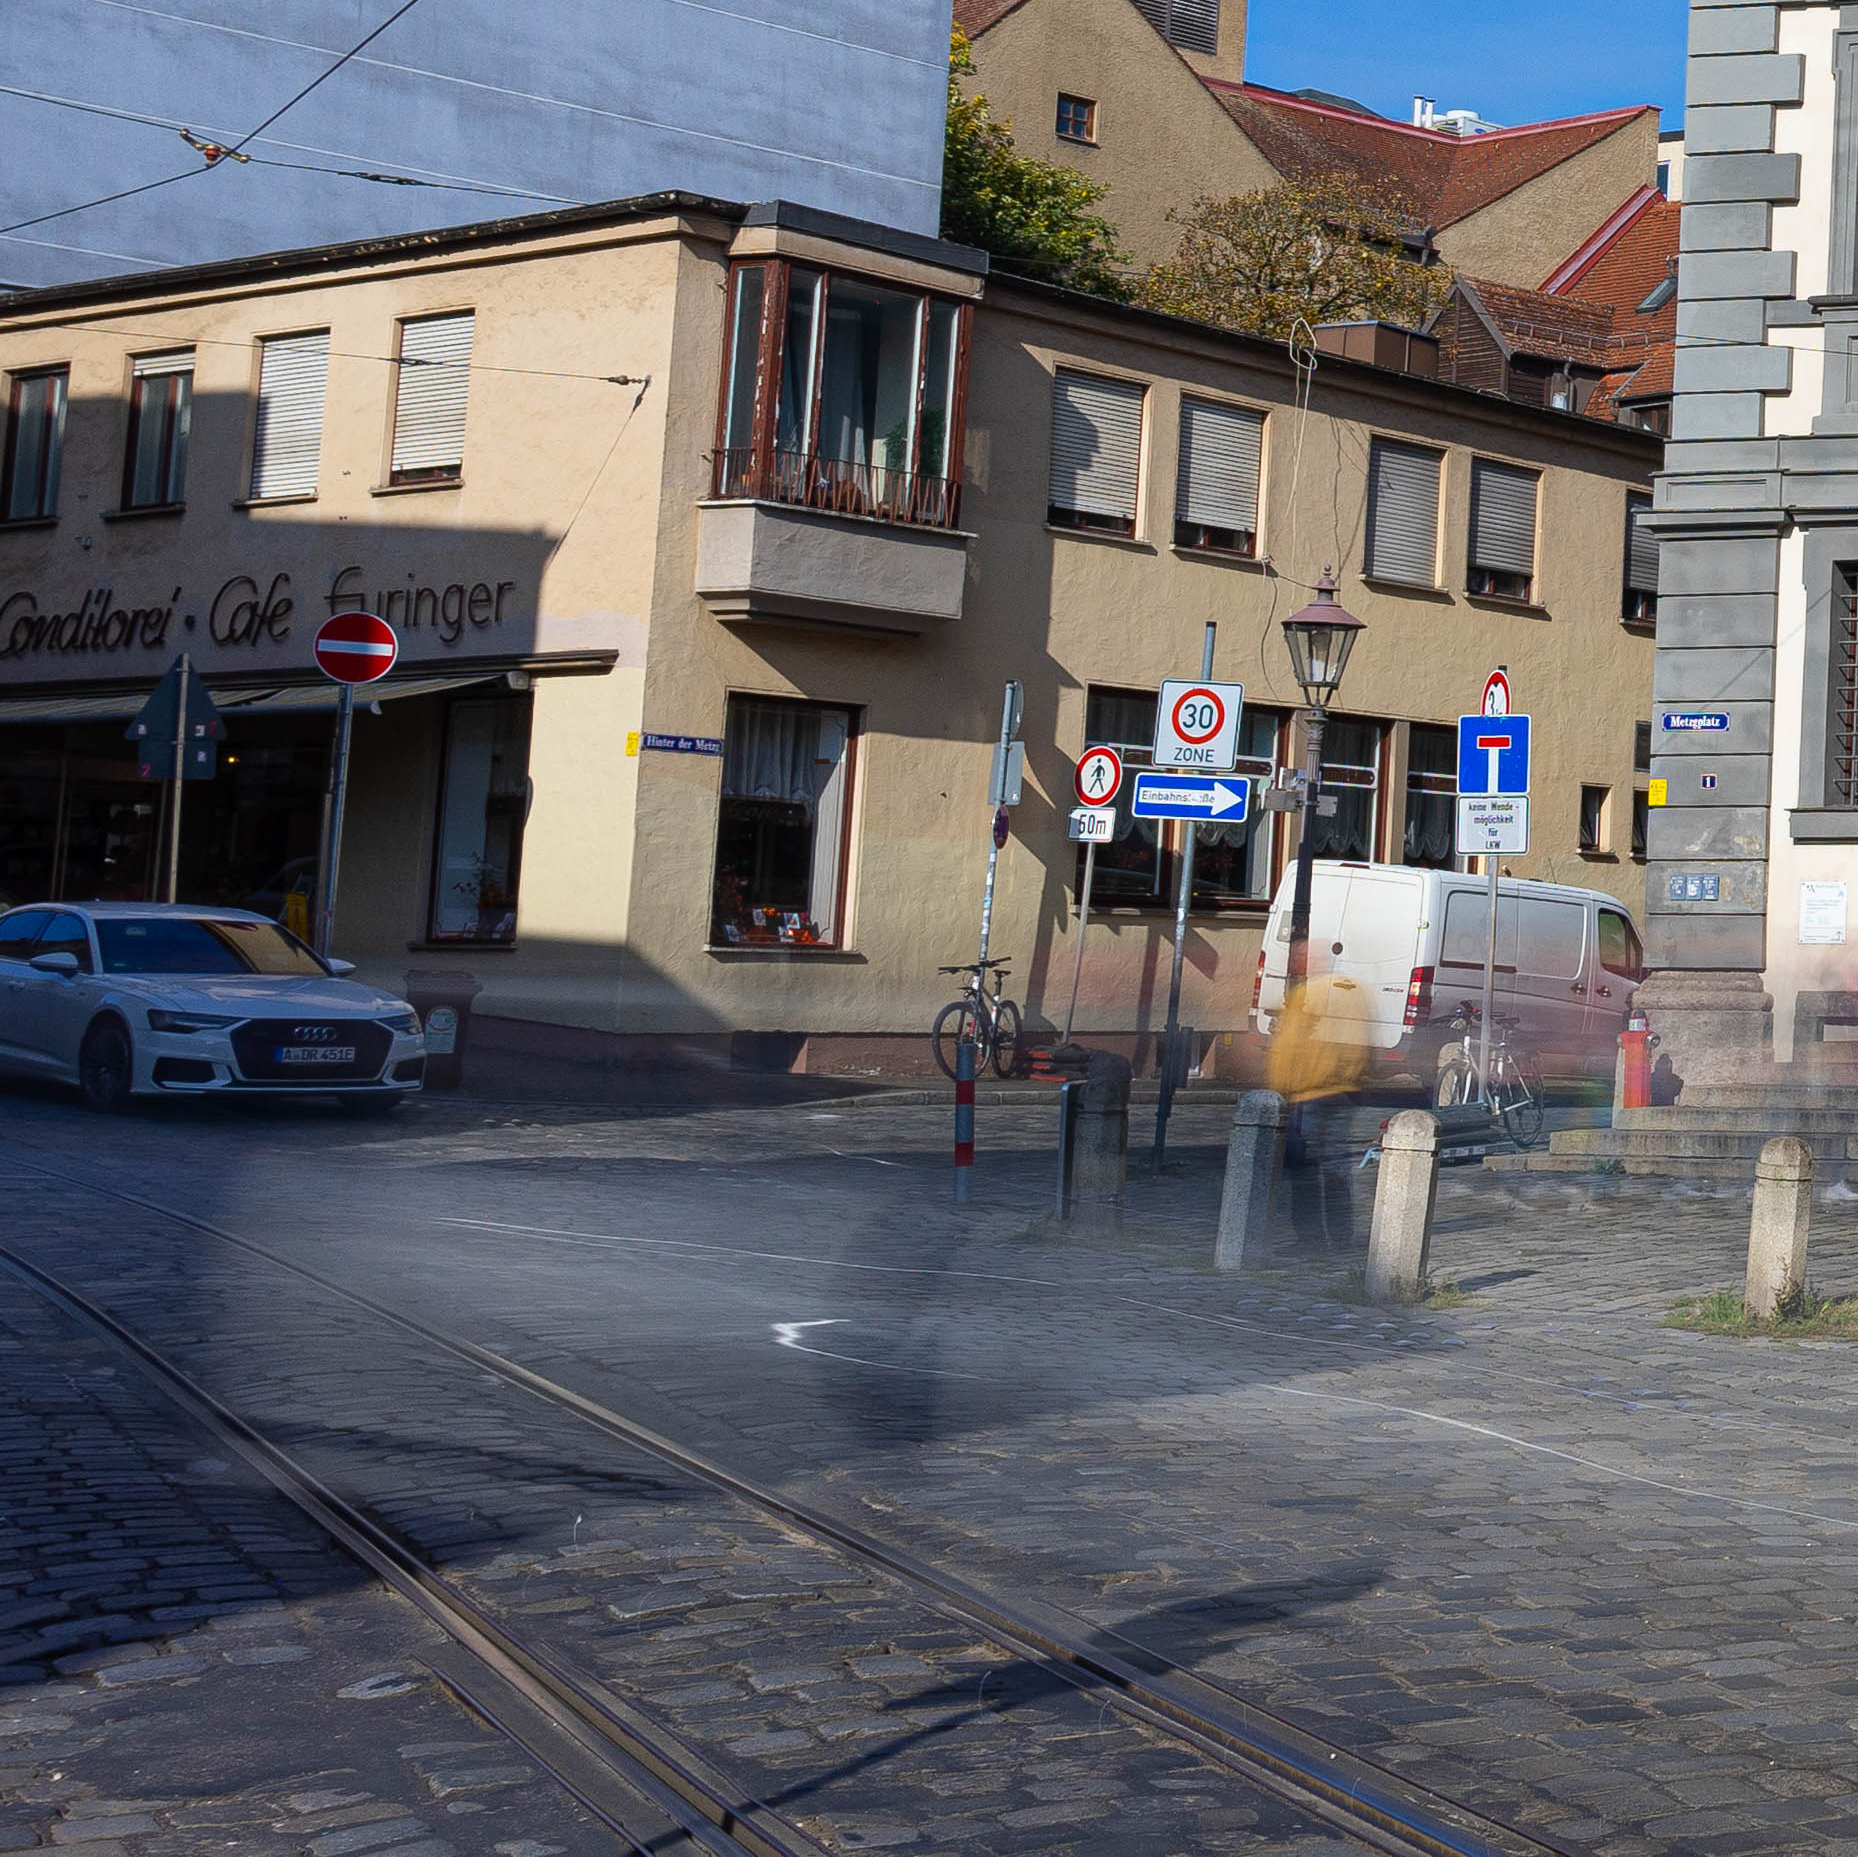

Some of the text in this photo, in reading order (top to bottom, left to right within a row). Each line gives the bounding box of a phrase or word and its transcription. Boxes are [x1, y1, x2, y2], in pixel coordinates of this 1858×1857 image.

[1182, 703, 1214, 729] 30
[1670, 715, 1721, 730] Metzgplatz
[646, 735, 675, 748] Hinter
[677, 737, 693, 749] der
[1173, 747, 1215, 763] ZONE
[1705, 776, 1711, 788] 1
[1078, 813, 1107, 835] 50m
